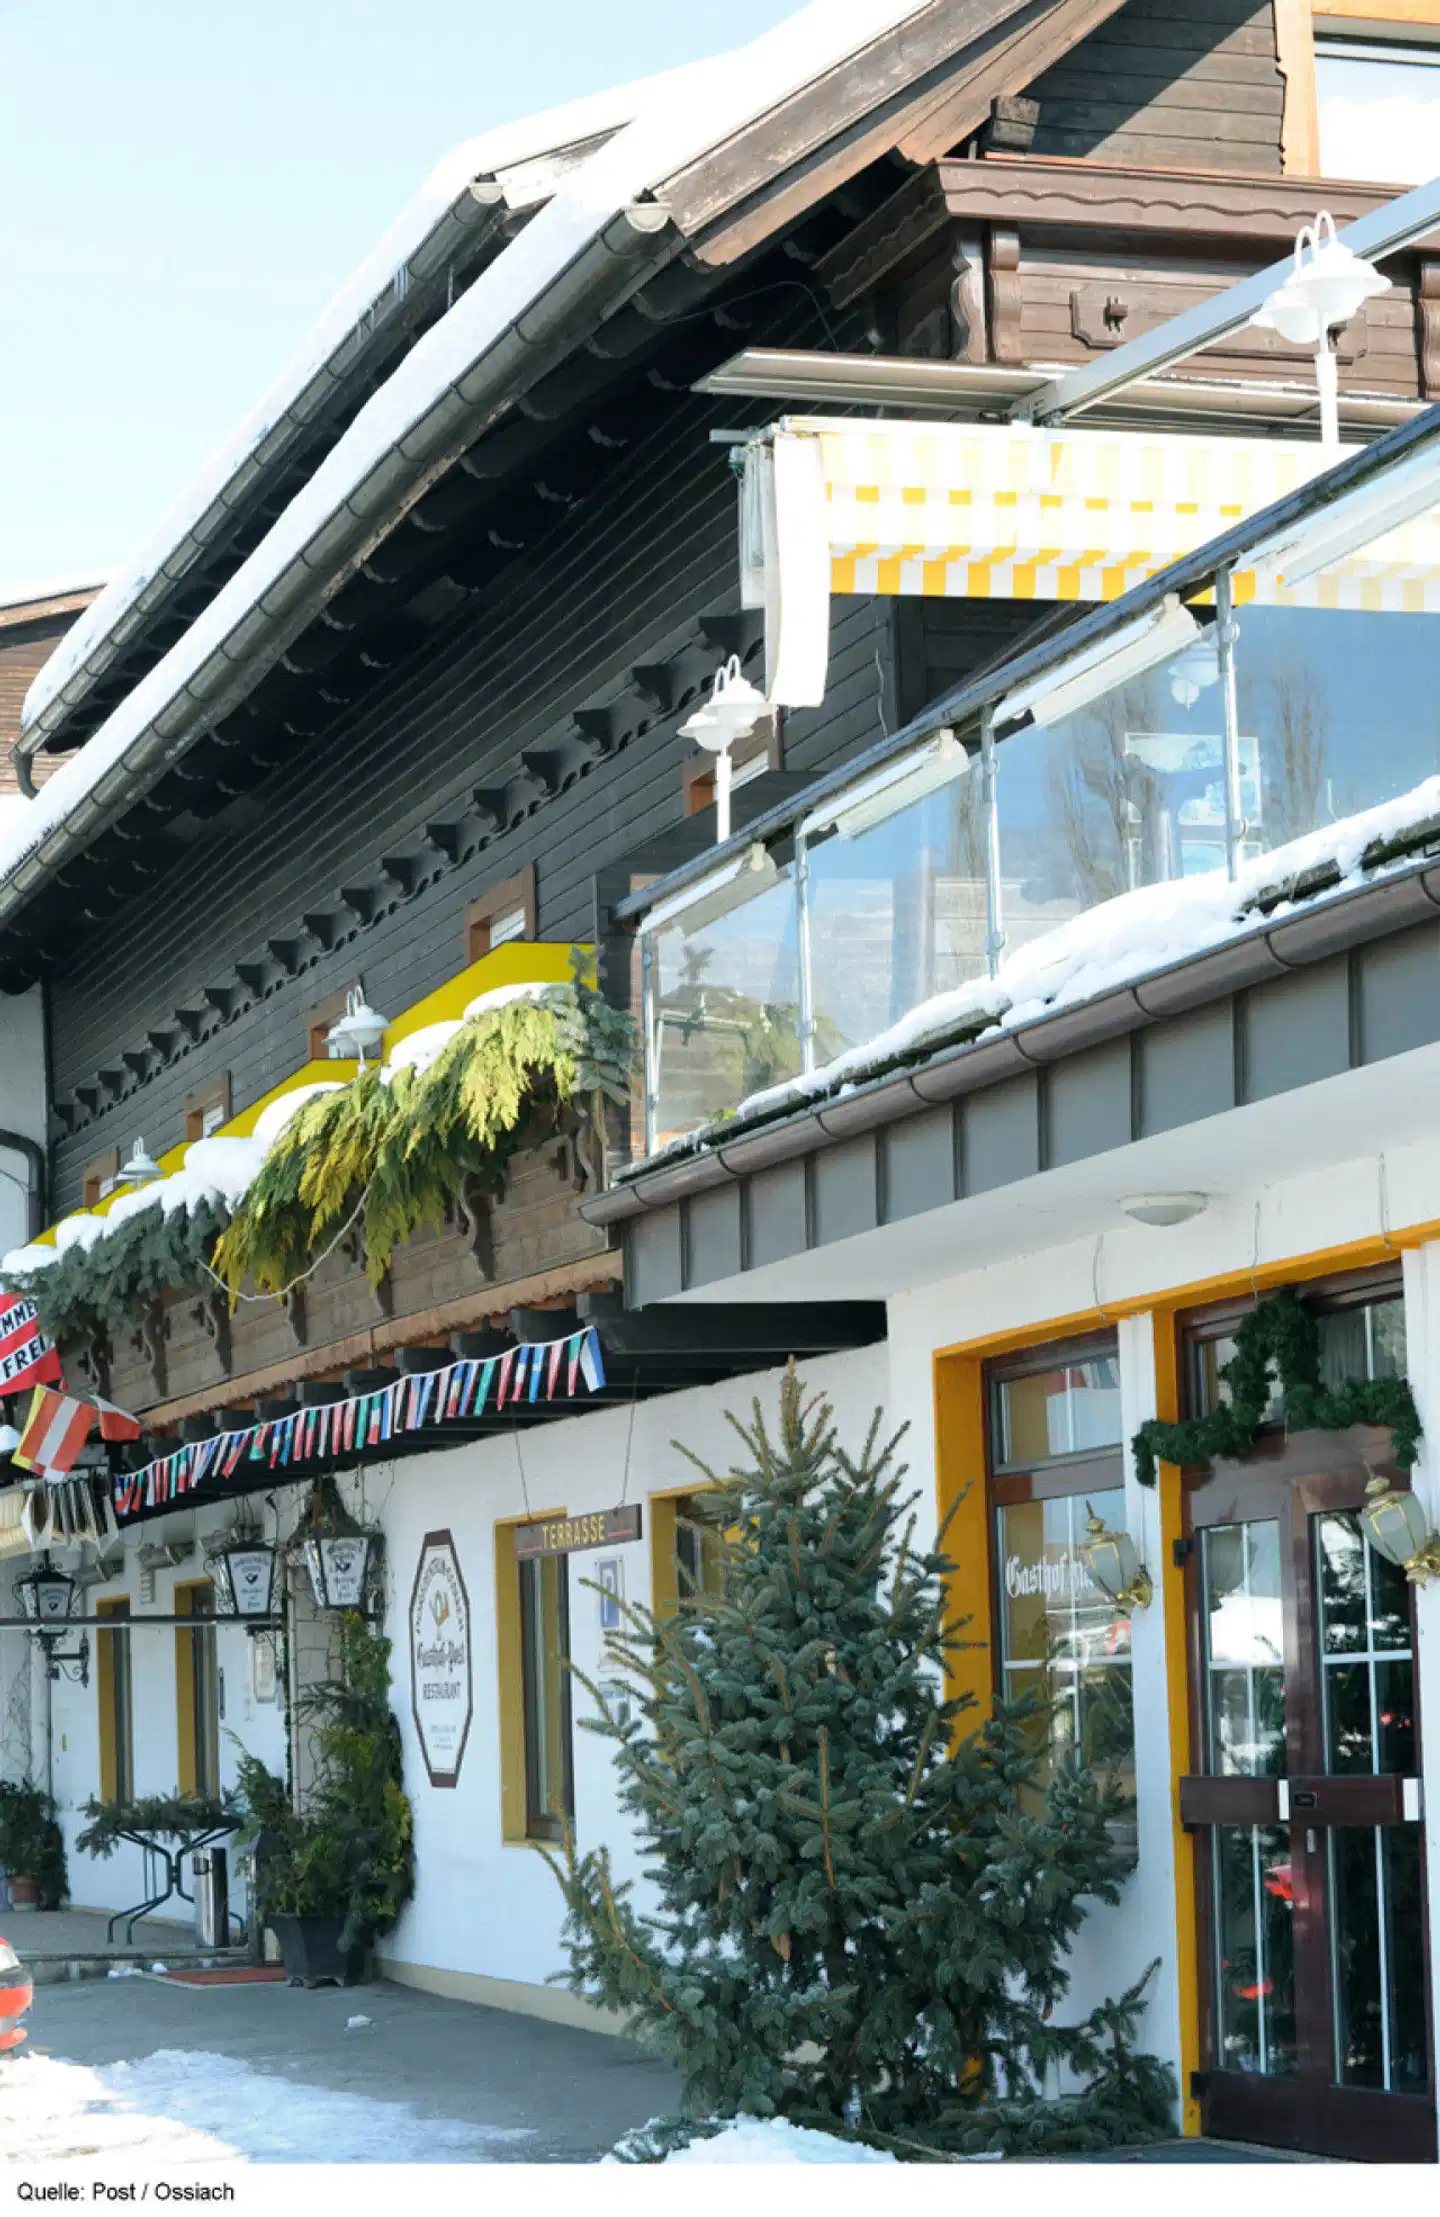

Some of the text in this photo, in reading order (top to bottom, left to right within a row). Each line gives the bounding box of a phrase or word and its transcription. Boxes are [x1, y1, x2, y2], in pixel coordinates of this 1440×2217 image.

[0, 1298, 37, 1339] MME
[3, 1333, 47, 1380] FREI
[542, 1515, 605, 1550] TERRASSE
